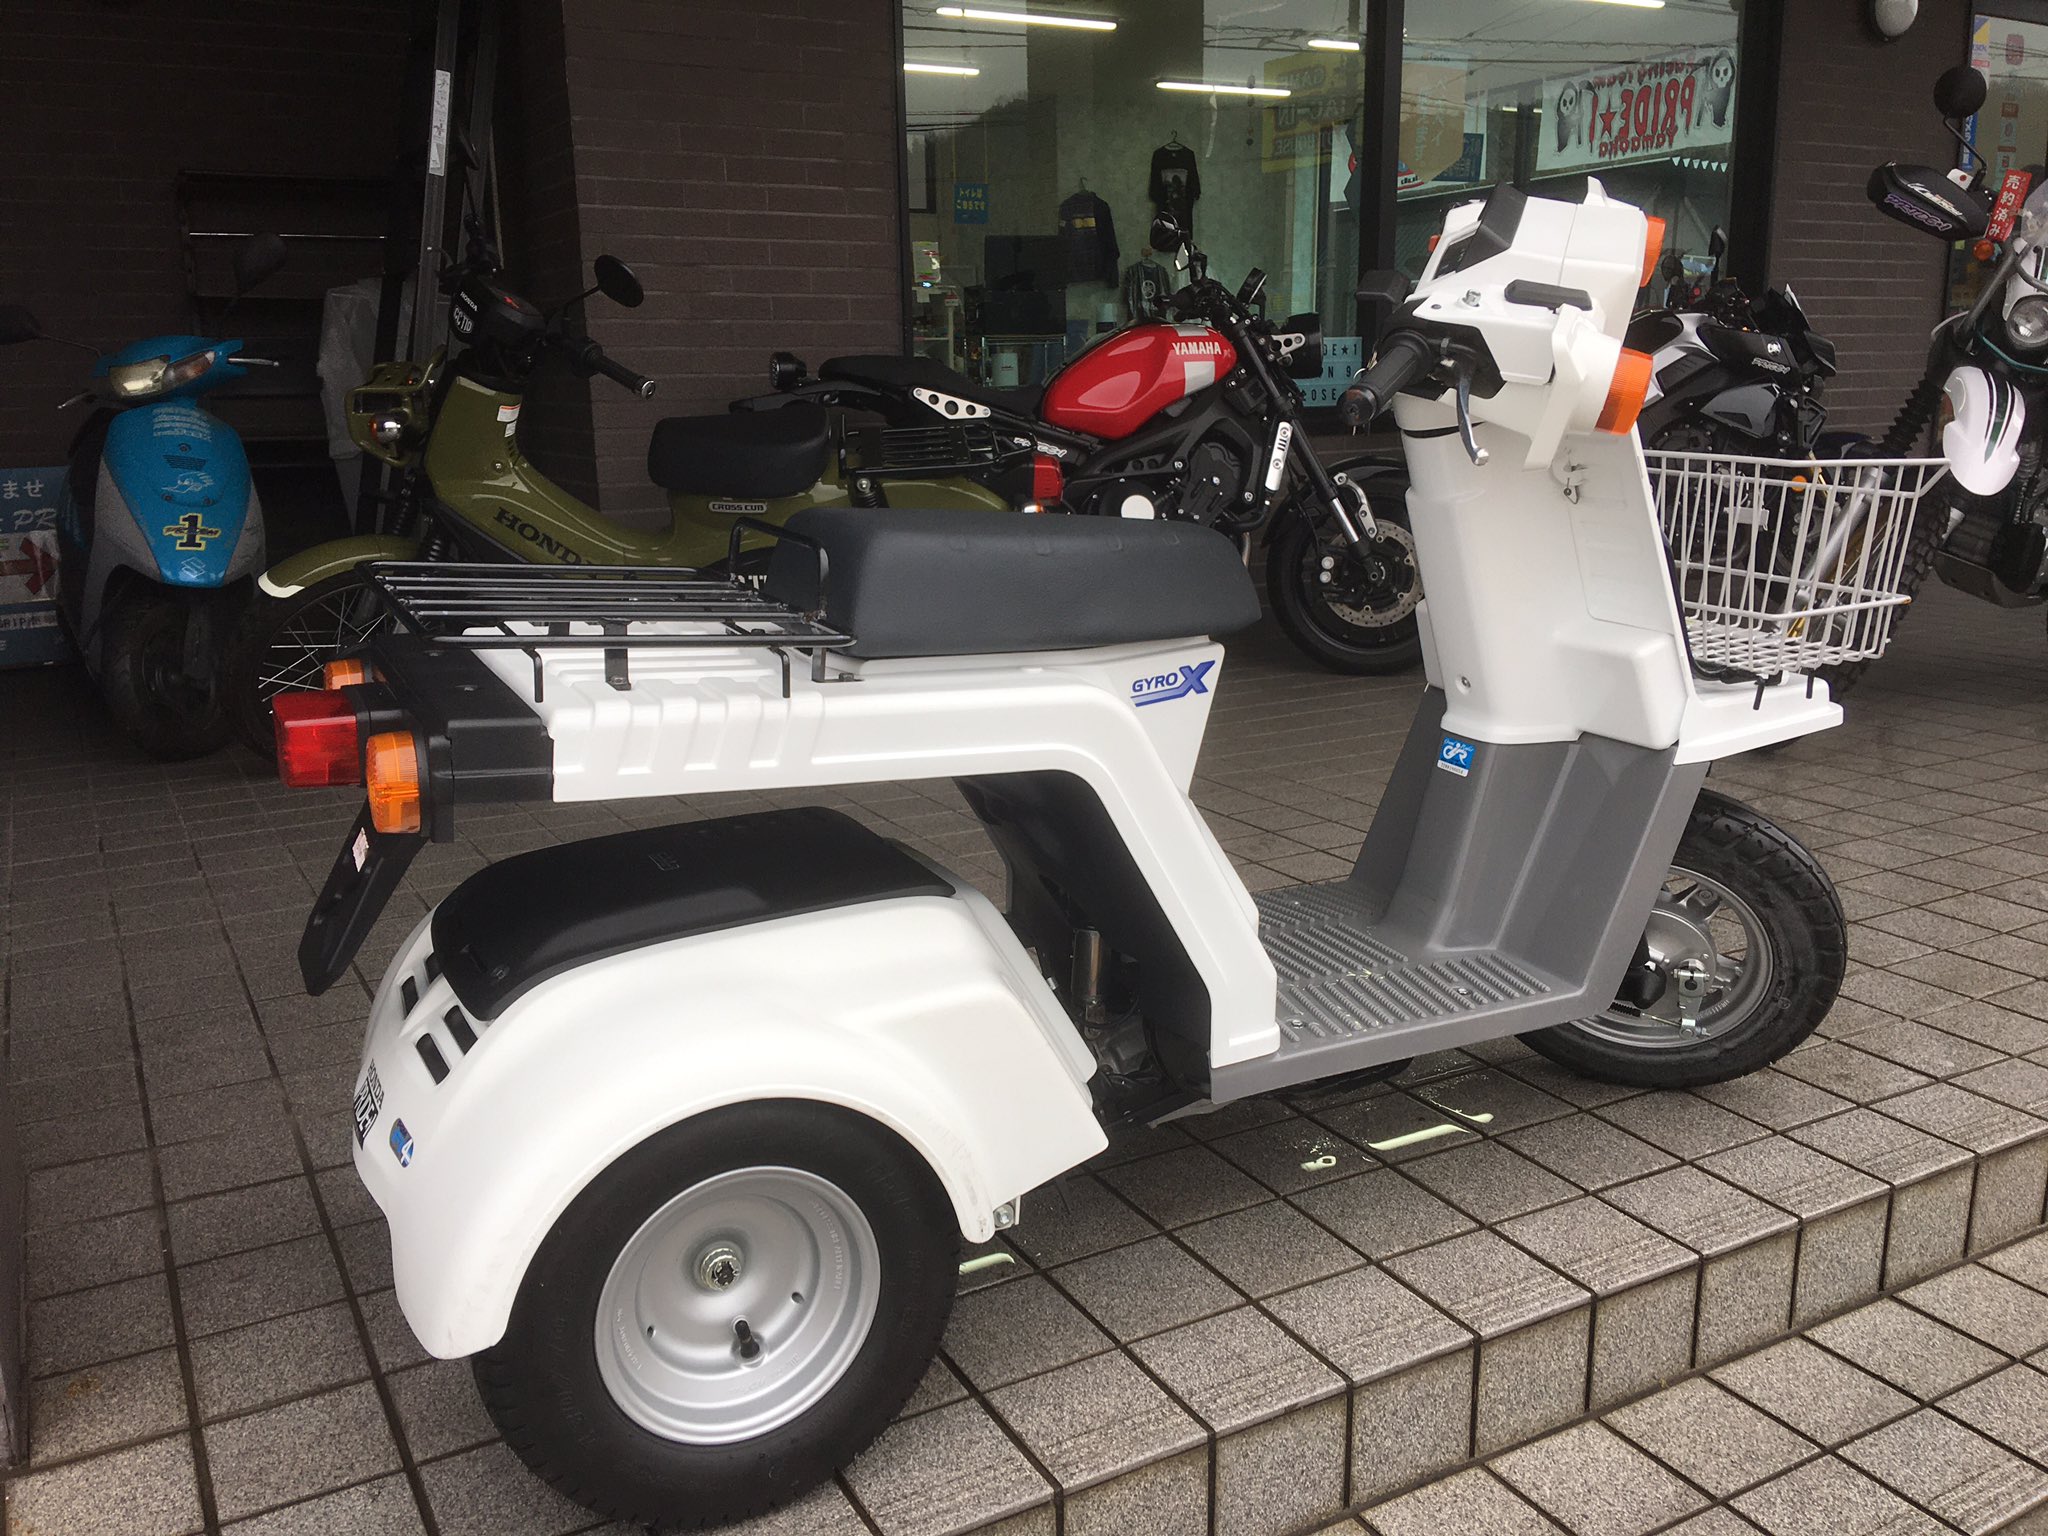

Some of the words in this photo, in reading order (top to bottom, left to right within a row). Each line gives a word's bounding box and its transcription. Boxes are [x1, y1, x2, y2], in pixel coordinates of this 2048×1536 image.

[1988, 175, 2020, 237] 売約済み
[460, 291, 478, 312] HONDA
[1171, 342, 1222, 356] YAMAHA
[712, 503, 743, 511] CROSS
[744, 503, 764, 511] CUB
[493, 507, 600, 566] HOND
[1131, 674, 1178, 694] GYRO
[1178, 659, 1216, 695] X
[368, 1058, 385, 1110] HONDA
